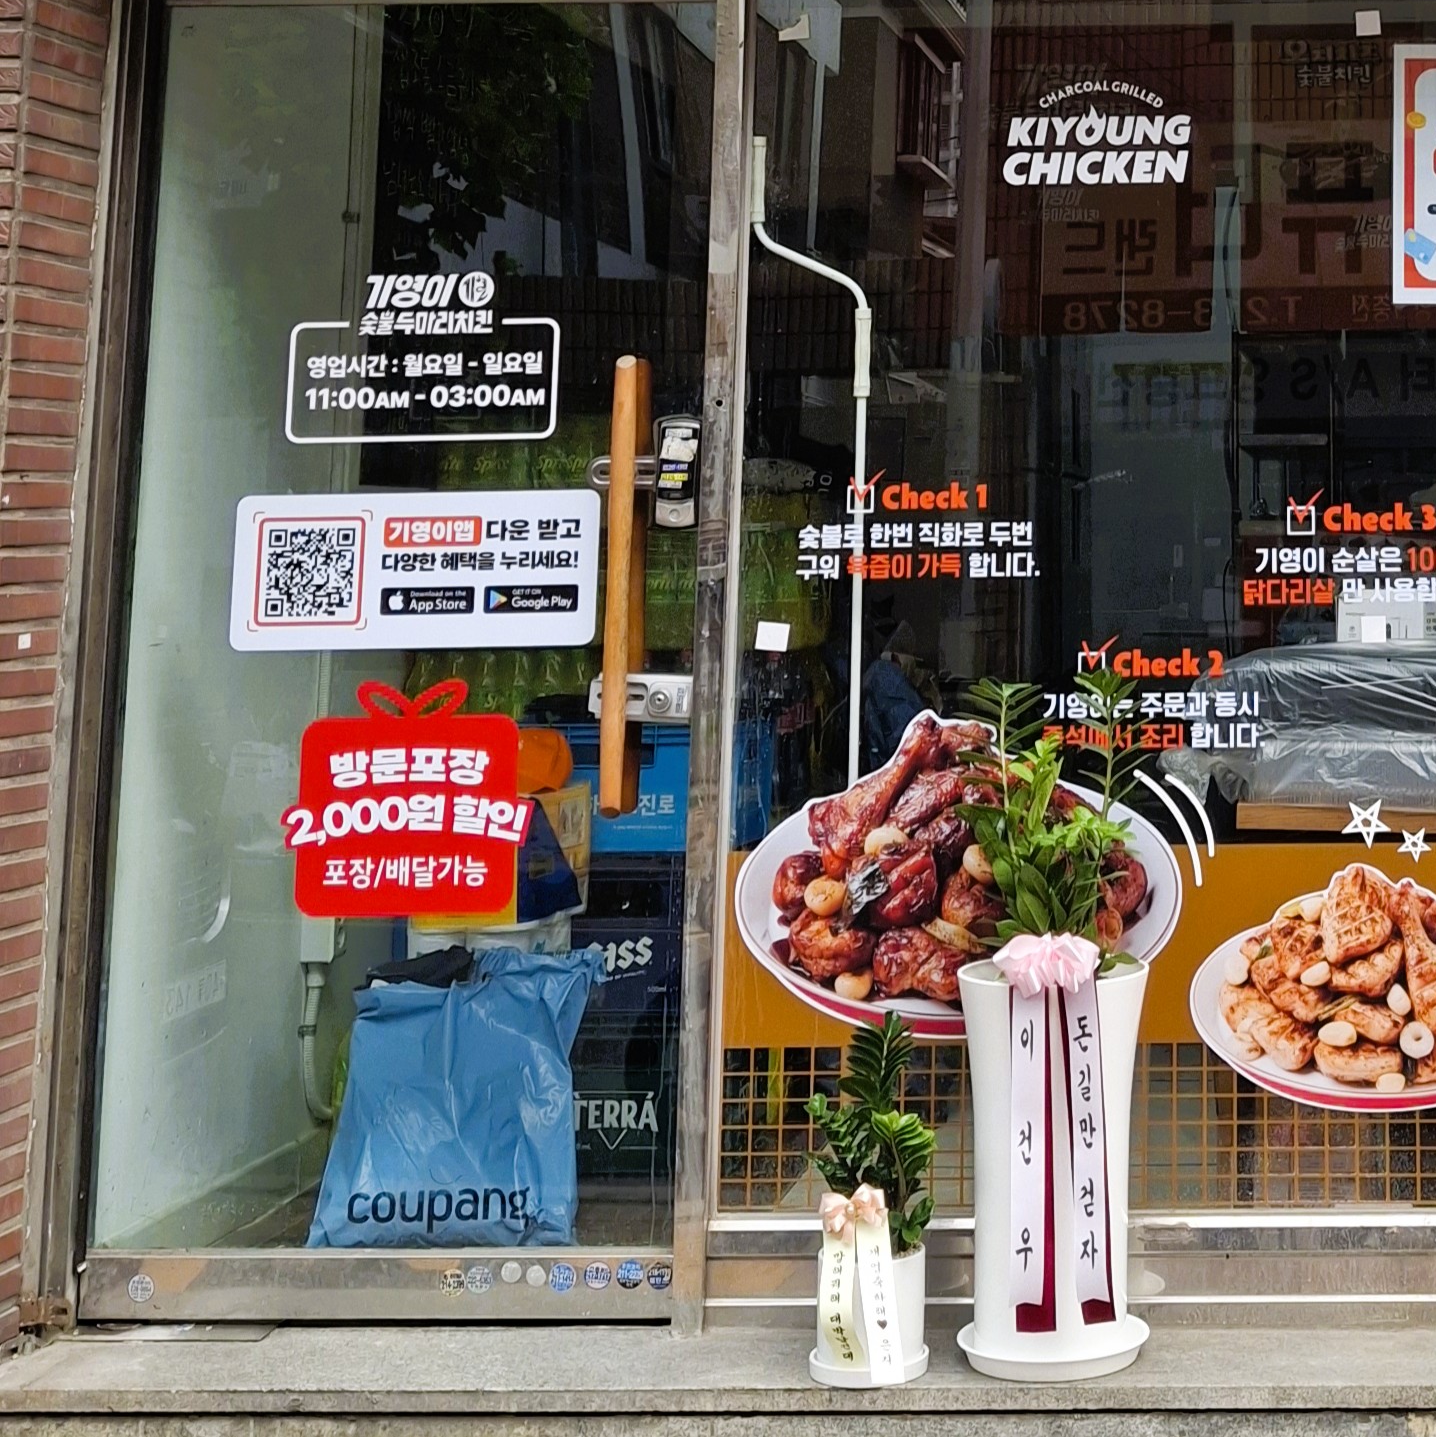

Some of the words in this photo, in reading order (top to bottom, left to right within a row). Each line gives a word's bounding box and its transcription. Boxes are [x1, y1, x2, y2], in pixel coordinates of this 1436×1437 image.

[1038, 79, 1109, 109] CHARCOAL
[1111, 80, 1164, 109] GRILLED
[1007, 104, 1191, 147] KIYOUNG
[1002, 149, 1189, 186] CHICKEN
[365, 273, 459, 309] 기영이
[358, 309, 493, 336] 숯불두마리치킨
[306, 353, 387, 379] 영업시간
[403, 352, 463, 377] 월요일
[483, 351, 543, 375] 일요일
[305, 386, 410, 410] 11:00AM
[430, 384, 545, 407] 03:00AM
[882, 481, 968, 511] Check
[975, 483, 988, 509] 1
[388, 519, 476, 544] 기영이앱
[485, 519, 530, 542] 다운
[537, 518, 582, 541] 받고
[1323, 502, 1413, 532] Check
[798, 523, 864, 549] 숯불로
[869, 522, 912, 548] 한번
[918, 521, 984, 547] 직화로
[989, 520, 1033, 547] 두번
[381, 552, 436, 572] 다양한
[440, 551, 495, 571] 혜택을
[499, 549, 579, 571] 누리세요!
[795, 554, 839, 580] 구워
[917, 553, 961, 578] 가득
[968, 552, 1040, 578] 합니다.
[1255, 547, 1325, 574] 기영이
[1331, 547, 1402, 573] 순살은
[409, 598, 432, 613] App
[434, 597, 467, 611] Store
[511, 596, 549, 610] Google
[551, 595, 573, 611] Play
[1243, 578, 1334, 606] 닭다리살
[1341, 579, 1364, 604] 만
[1113, 647, 1200, 678] Check
[1208, 650, 1224, 677] 2
[1140, 691, 1209, 717] 주문과
[1215, 691, 1259, 717] 동시
[1139, 723, 1184, 749] 조리
[1190, 722, 1266, 748] 합니다.
[329, 746, 489, 789] 방문포장
[286, 795, 444, 847] 2,000원
[452, 795, 528, 842] 할인
[322, 856, 489, 890] 포장/배달가능
[573, 1098, 659, 1132] TERRA
[347, 1186, 531, 1233] coupang
[1079, 1177, 1099, 1270] 걷자
